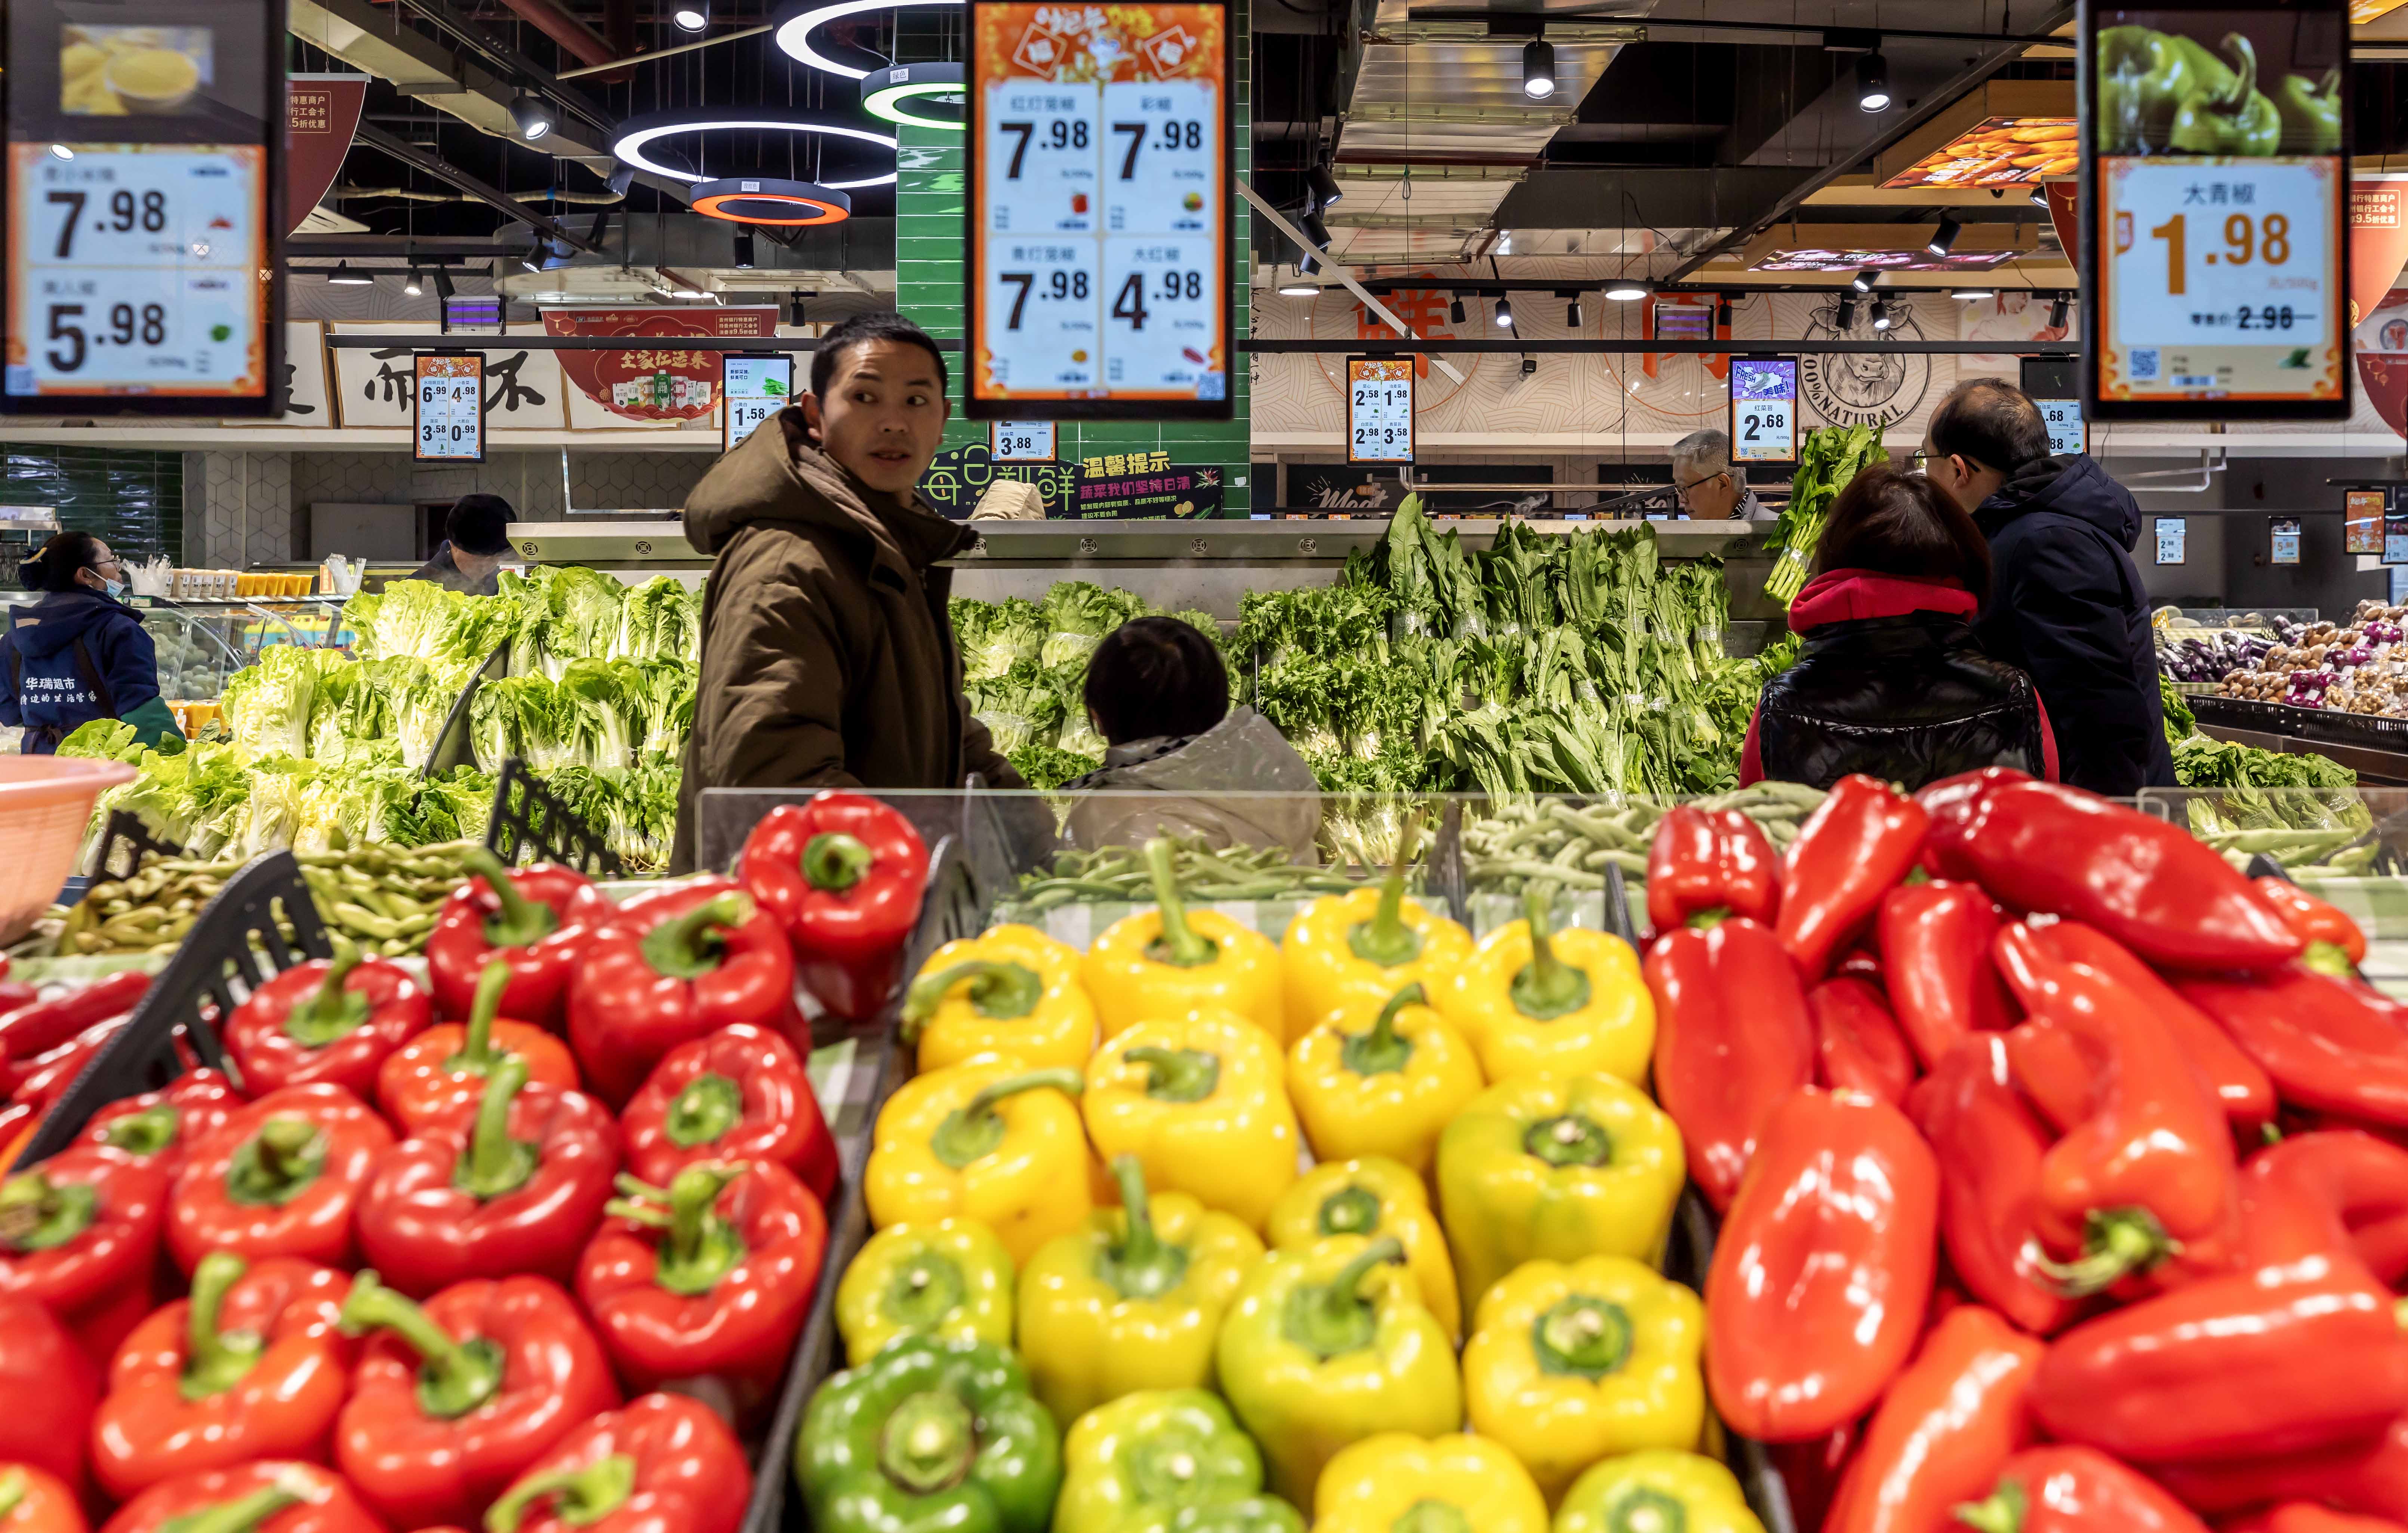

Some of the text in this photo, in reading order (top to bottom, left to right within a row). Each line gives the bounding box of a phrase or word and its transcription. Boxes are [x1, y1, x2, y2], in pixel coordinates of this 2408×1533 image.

[893, 71, 906, 79] 绿色
[287, 96, 325, 104] 特惠商户
[287, 108, 325, 116] 行工会卡
[1000, 120, 1088, 179] 7.98
[1114, 120, 1201, 179] 7.98
[2183, 182, 2256, 205] 大青椒
[46, 190, 165, 258] 7.98
[2151, 213, 2291, 295] 1.98
[1000, 271, 1088, 330] 7.98
[1112, 271, 1202, 330] 4.98
[46, 304, 165, 372] 5.98
[1735, 365, 1756, 383] FRESH
[423, 387, 446, 403] 6.99
[452, 387, 475, 403] 4.98
[1355, 390, 1379, 406] 2.58
[1384, 390, 1407, 406] 1.98
[1804, 353, 1903, 427] 00% NATURAL
[735, 408, 765, 426] 1.58
[423, 425, 446, 441] 3.58
[452, 425, 475, 441] 0.99
[1355, 428, 1379, 444] 2.98
[1384, 428, 1407, 444] 3.58
[1744, 415, 1783, 440] 2.68
[1001, 437, 1031, 455] 3.88
[1083, 451, 1170, 478] 温馨提示
[1080, 476, 1191, 499] 蔬菜我们坚持日清
[1081, 510, 1118, 519] 建议不要食用
[26, 677, 75, 690] 华瑞超市
